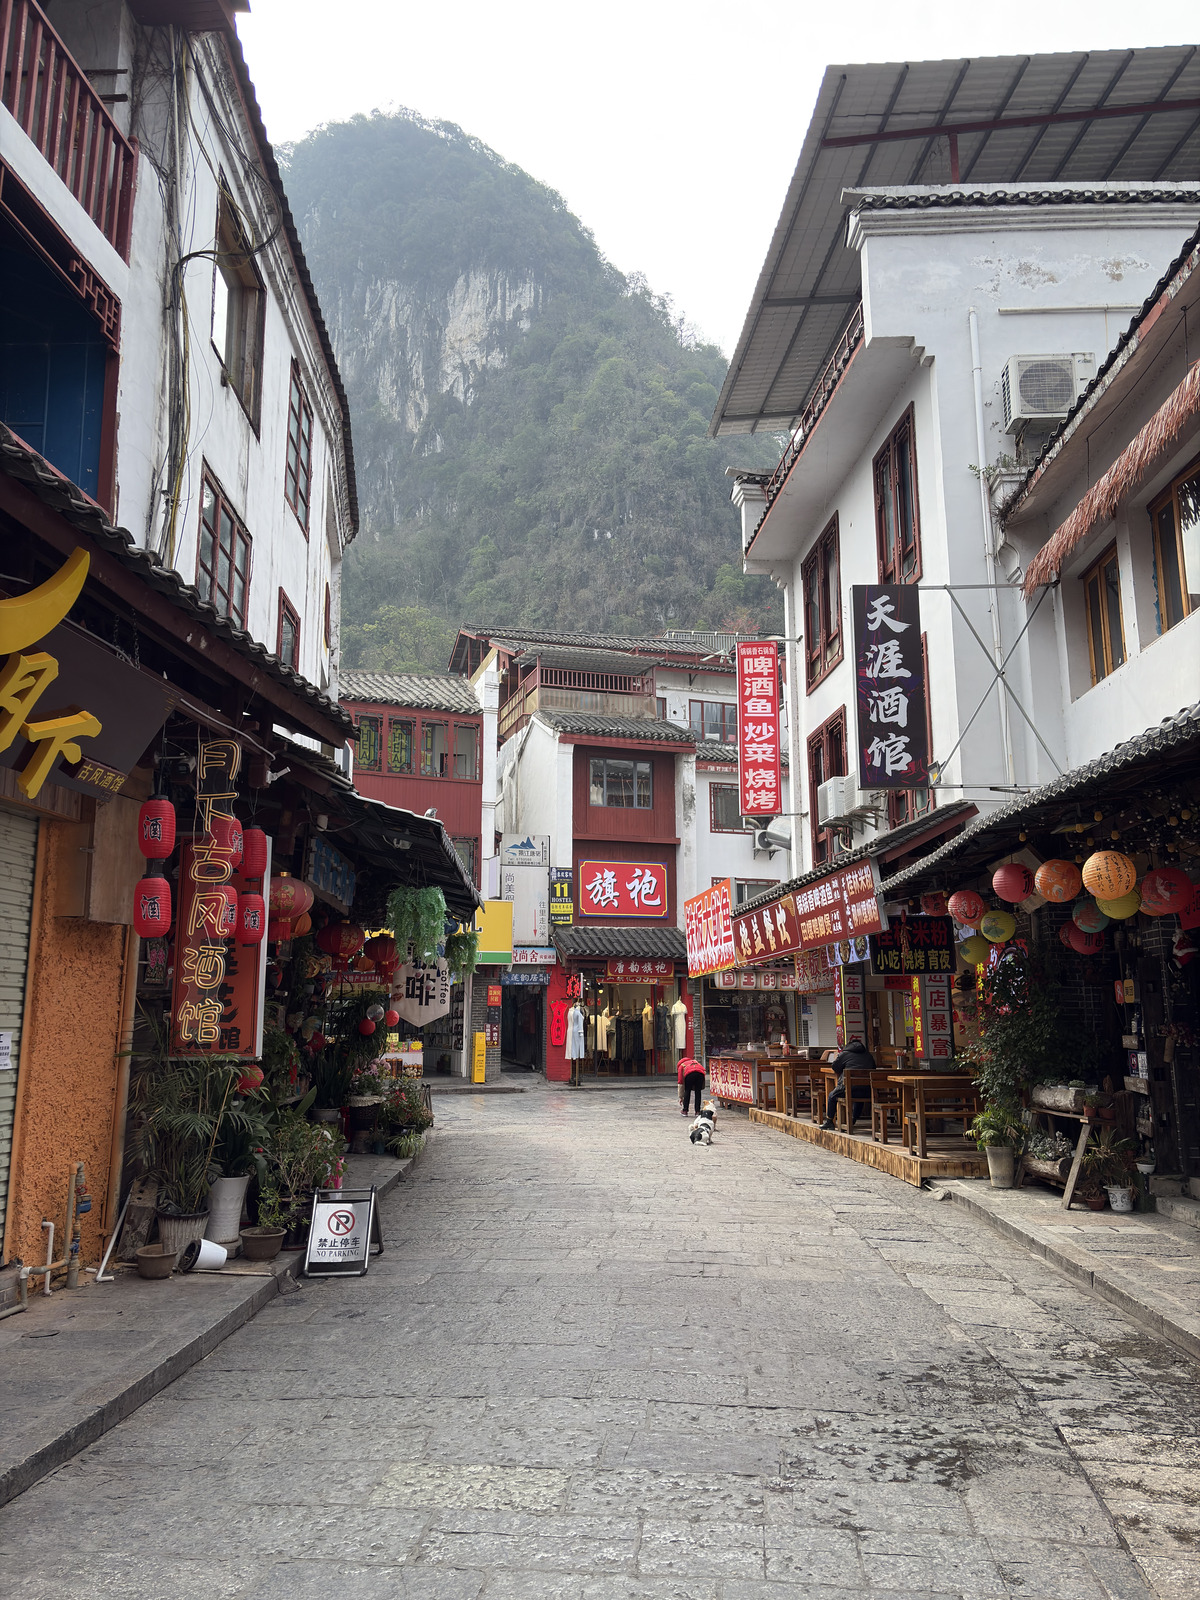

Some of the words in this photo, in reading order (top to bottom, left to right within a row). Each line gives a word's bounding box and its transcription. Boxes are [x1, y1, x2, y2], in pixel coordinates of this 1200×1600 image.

[743, 655, 774, 717] 啤酒鱼
[866, 594, 912, 777] 天涯酒馆
[744, 722, 775, 763] 炒菜
[745, 768, 776, 810] 烧烤
[143, 815, 162, 841] 酒
[179, 739, 242, 1043] 月下古风酒馆
[553, 882, 568, 897] 11
[585, 867, 662, 909] 旗袍
[845, 864, 874, 897] 桂林米粉
[140, 895, 161, 920] 酒
[244, 907, 261, 930] 酒
[685, 886, 733, 950] 铁板大鱿鱼
[614, 960, 667, 974] 唐韵旗袍
[877, 950, 900, 970] 小吃
[903, 950, 925, 970] 烧烤
[928, 949, 951, 970] 宵夜
[439, 970, 447, 1005] coffee
[711, 1062, 752, 1089] 铁板鱿鱼
[318, 1237, 360, 1247] 禁止停车
